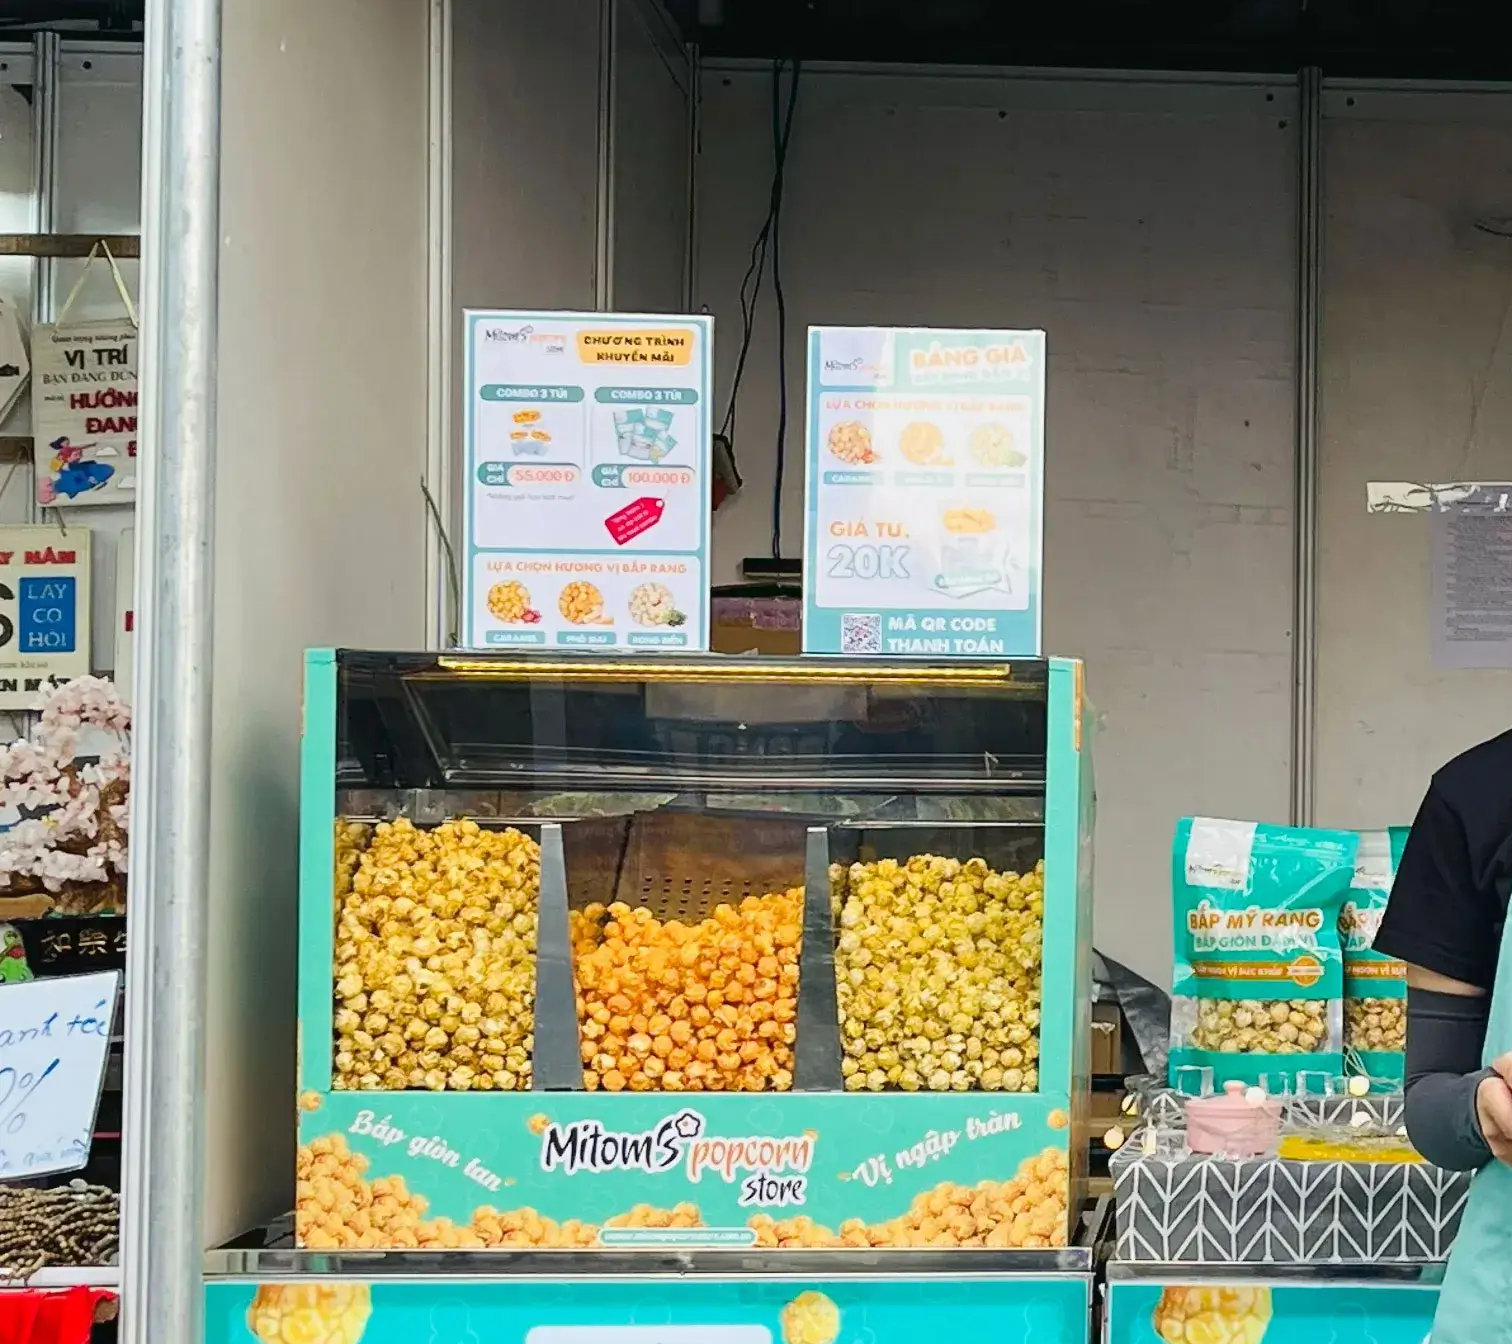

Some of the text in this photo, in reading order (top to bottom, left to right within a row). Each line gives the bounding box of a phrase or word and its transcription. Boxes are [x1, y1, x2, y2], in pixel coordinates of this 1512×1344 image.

[64, 344, 128, 369] VỊ TRÍ
[827, 545, 910, 579] 20K
[922, 617, 996, 631] QR CODE
[888, 638, 950, 652] THANH
[1262, 912, 1319, 927] RANG
[690, 1139, 809, 1177] popcorn
[464, 1158, 503, 1191] tan
[744, 1173, 802, 1202] store
